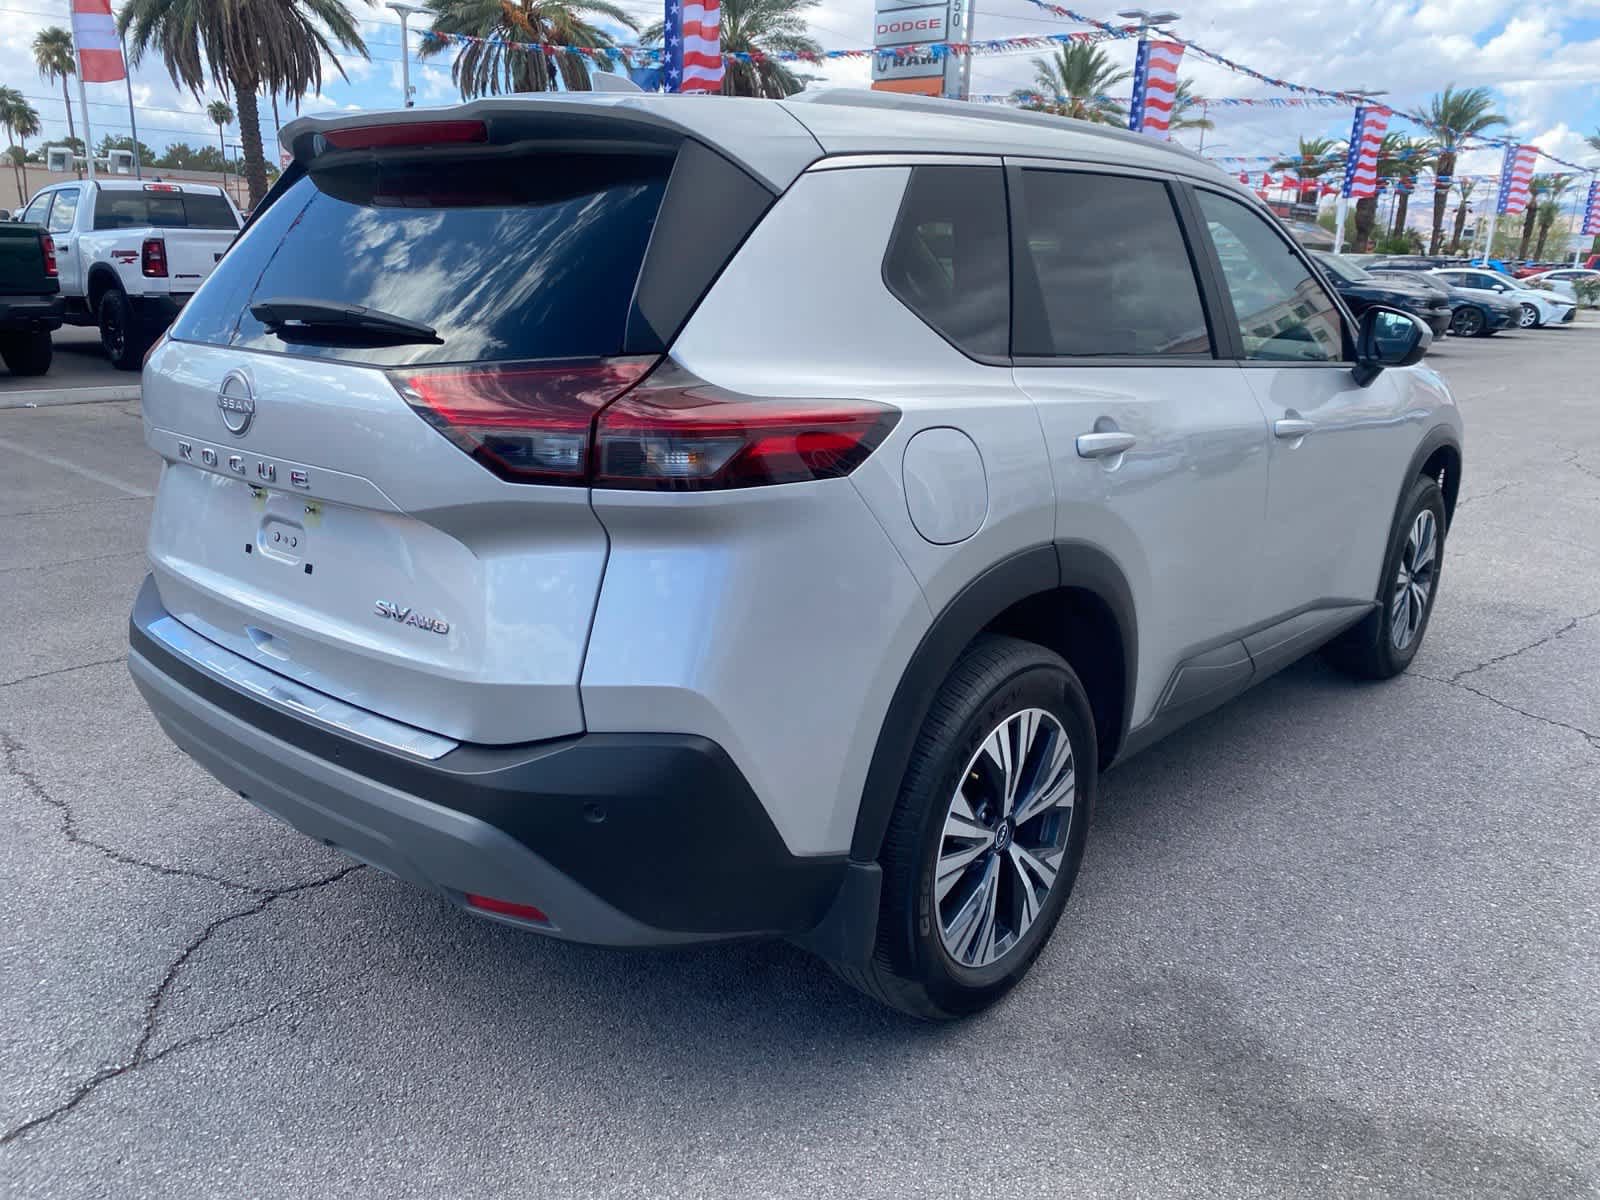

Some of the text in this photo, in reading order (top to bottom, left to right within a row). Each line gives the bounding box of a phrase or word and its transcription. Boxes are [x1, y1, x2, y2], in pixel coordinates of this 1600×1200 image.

[877, 19, 941, 35] DODGE
[892, 54, 939, 67] RAM
[179, 440, 310, 489] ROGUE
[406, 615, 449, 635] AWD
